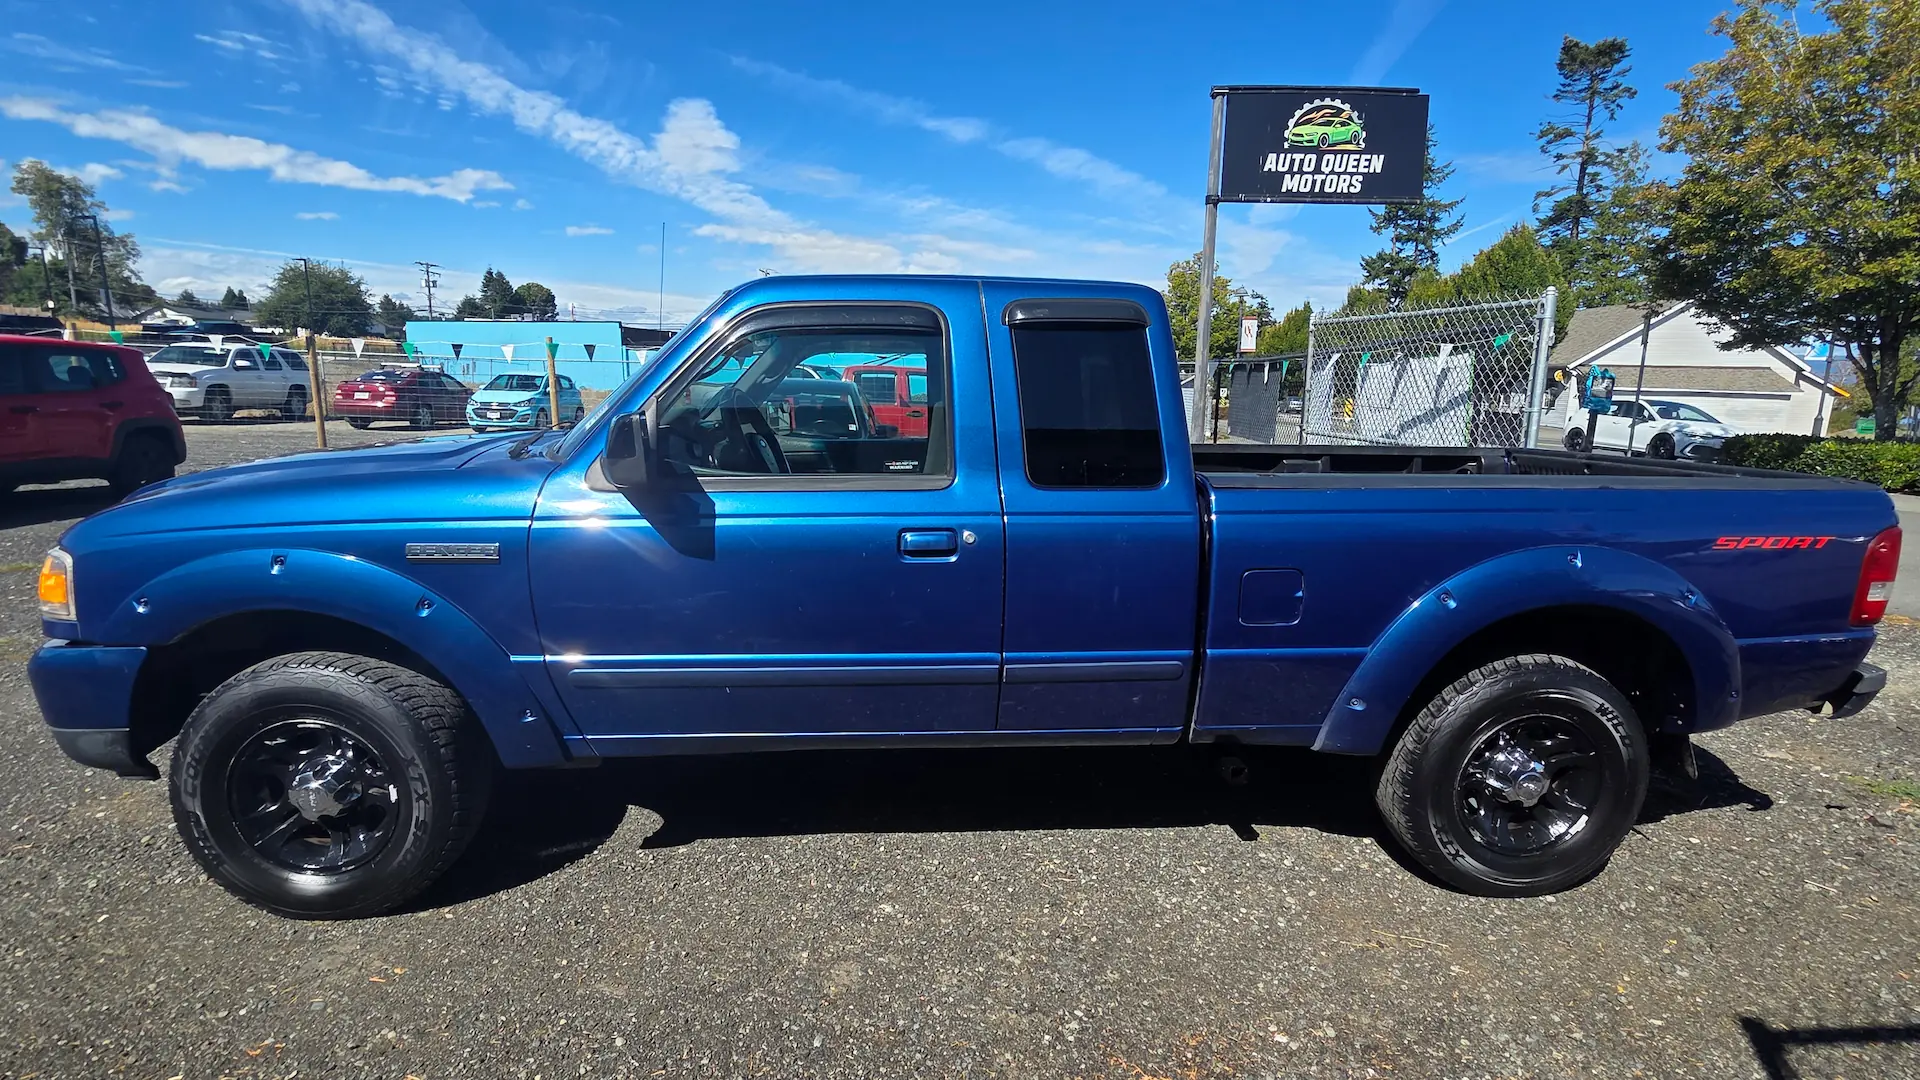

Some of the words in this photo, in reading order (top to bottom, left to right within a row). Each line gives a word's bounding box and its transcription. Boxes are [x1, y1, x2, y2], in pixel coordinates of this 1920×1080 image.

[1263, 153, 1317, 172] AUTO
[1320, 153, 1385, 175] QUEEN
[1281, 174, 1363, 194] MOTORS
[1711, 536, 1837, 549] SPORT
